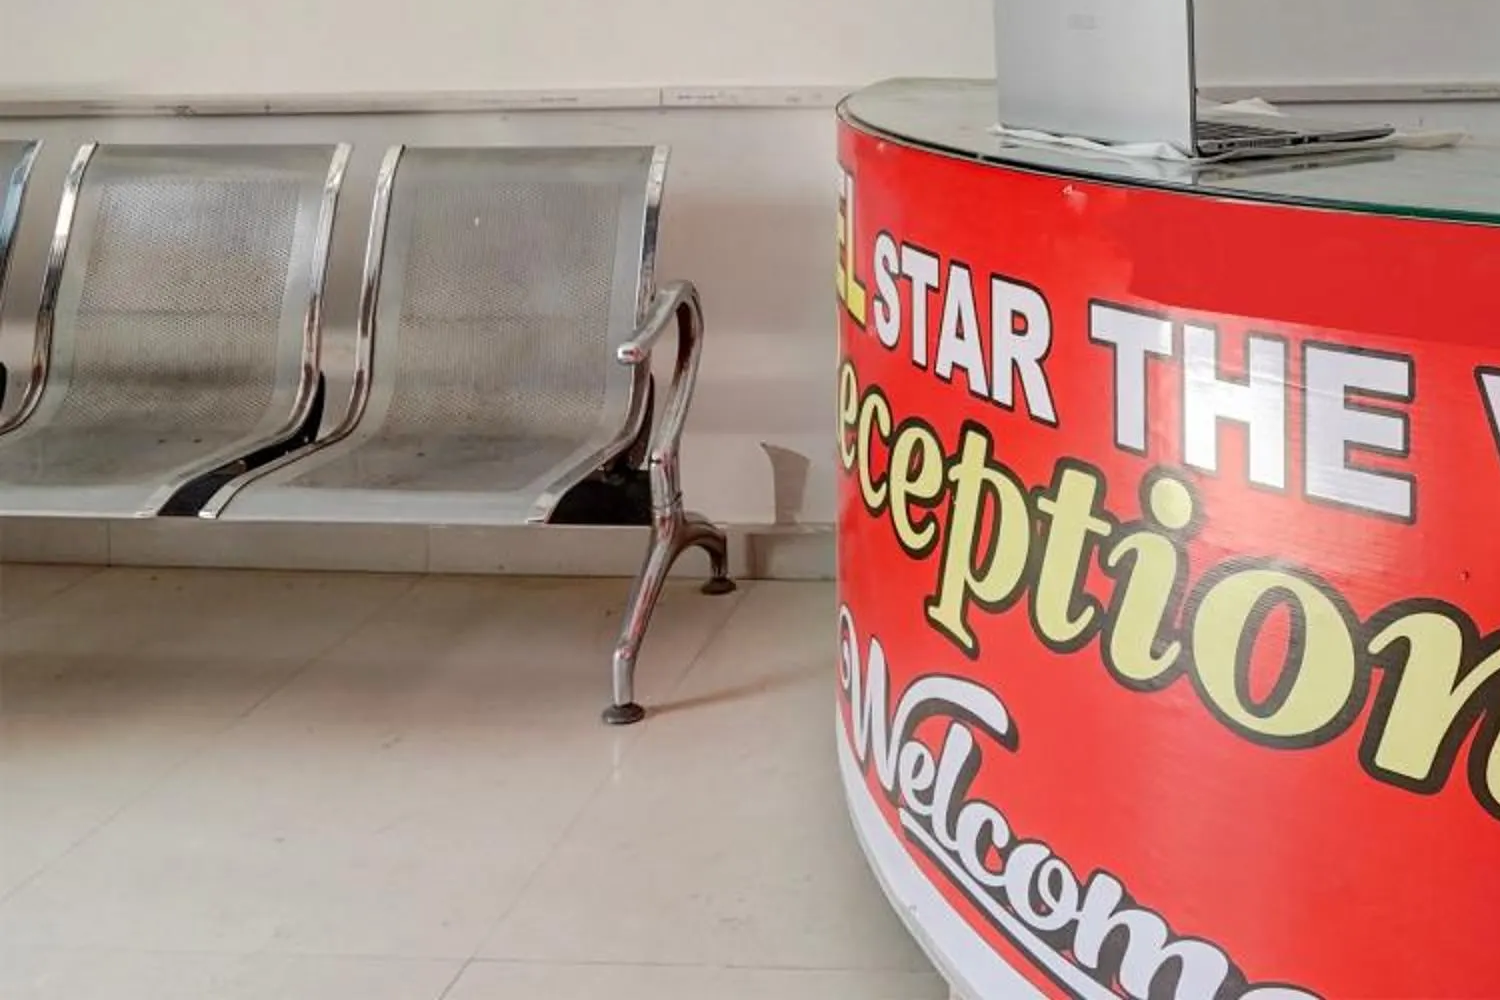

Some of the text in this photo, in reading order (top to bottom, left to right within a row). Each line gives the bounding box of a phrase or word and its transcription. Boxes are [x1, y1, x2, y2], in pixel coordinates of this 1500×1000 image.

[872, 230, 1060, 428] STAR
[1087, 298, 1415, 525] THE
[838, 603, 1330, 1000] Welcom
